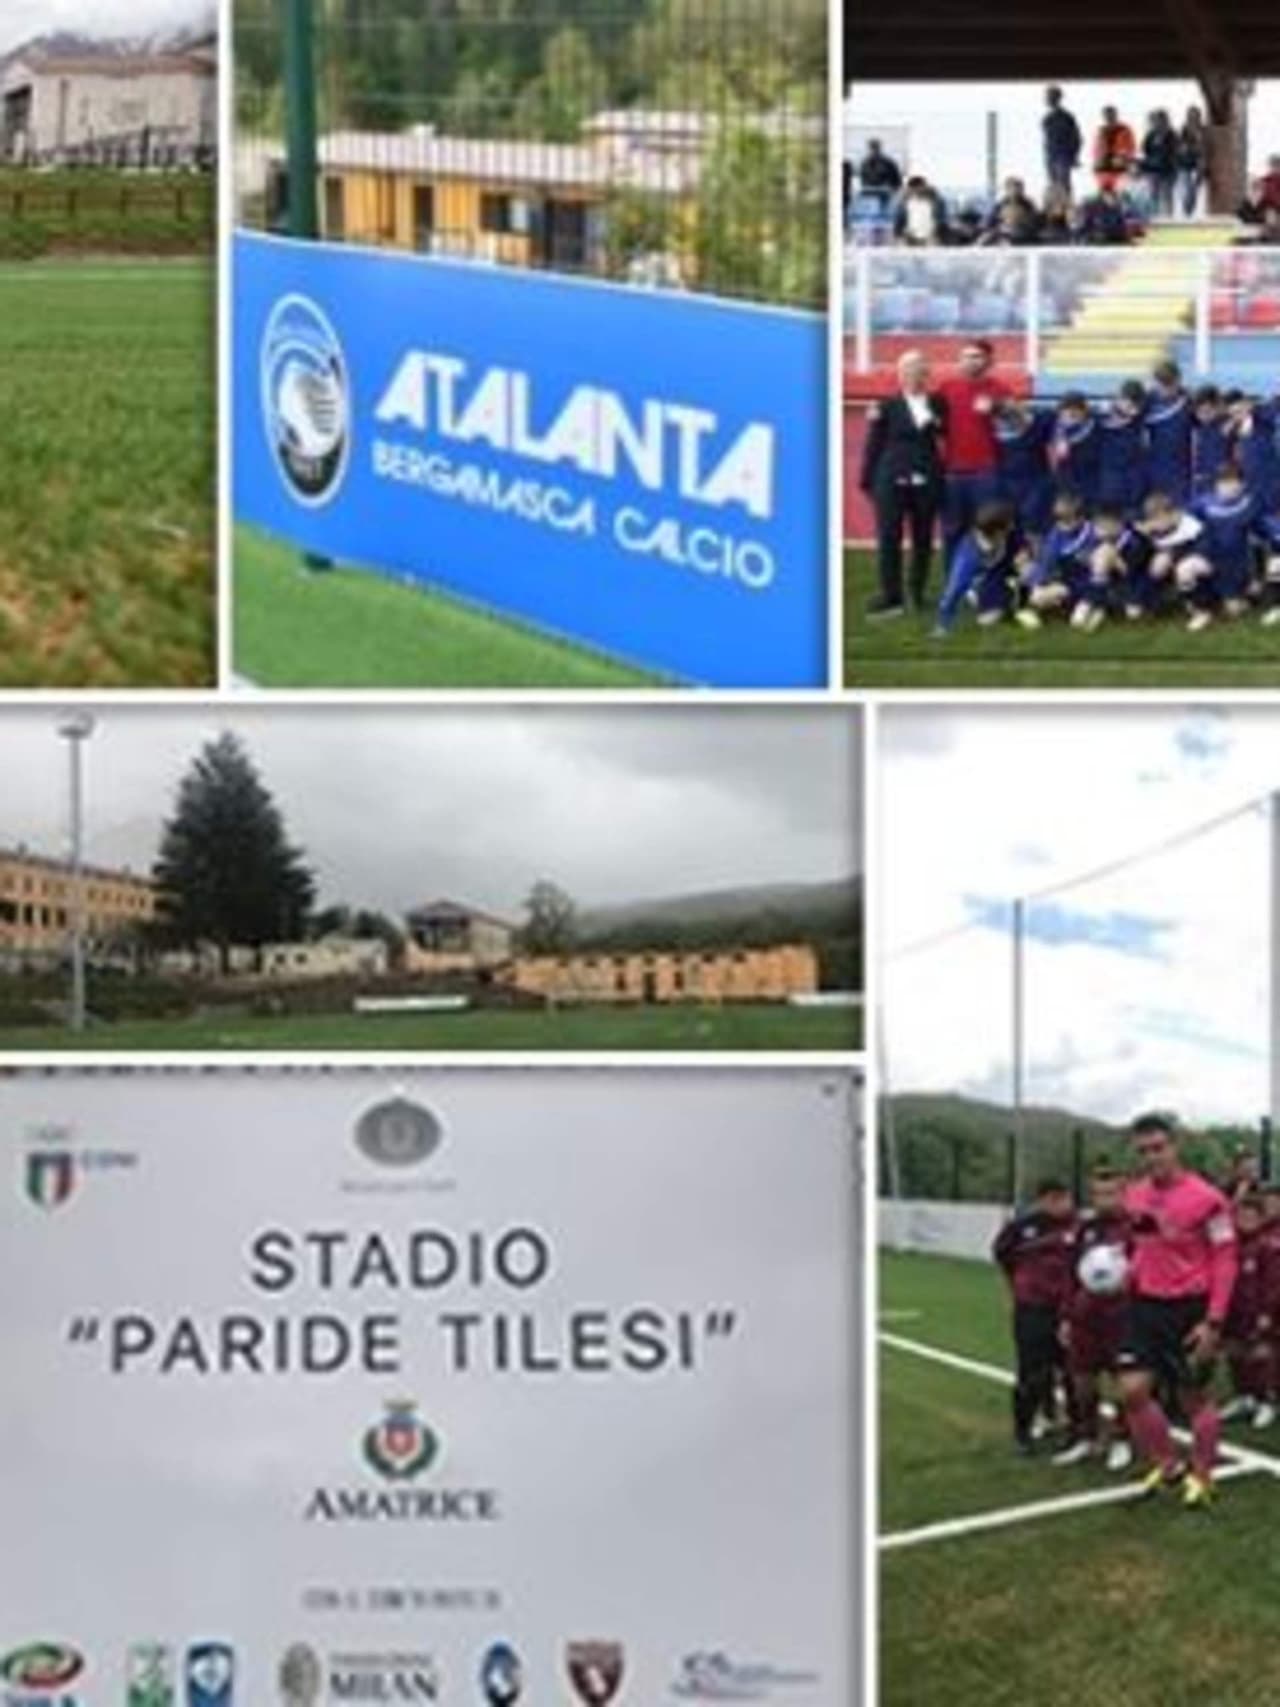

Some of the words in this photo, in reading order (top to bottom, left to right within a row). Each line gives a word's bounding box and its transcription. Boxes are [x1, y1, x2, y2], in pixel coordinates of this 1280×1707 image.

[374, 350, 774, 517] ATALANTA
[372, 440, 596, 535] BERGAMASCA
[613, 508, 775, 588] CALCIO
[250, 1228, 551, 1292] STADIO
[304, 1488, 500, 1520] AMATRICE
[329, 1673, 437, 1700] MILAN
